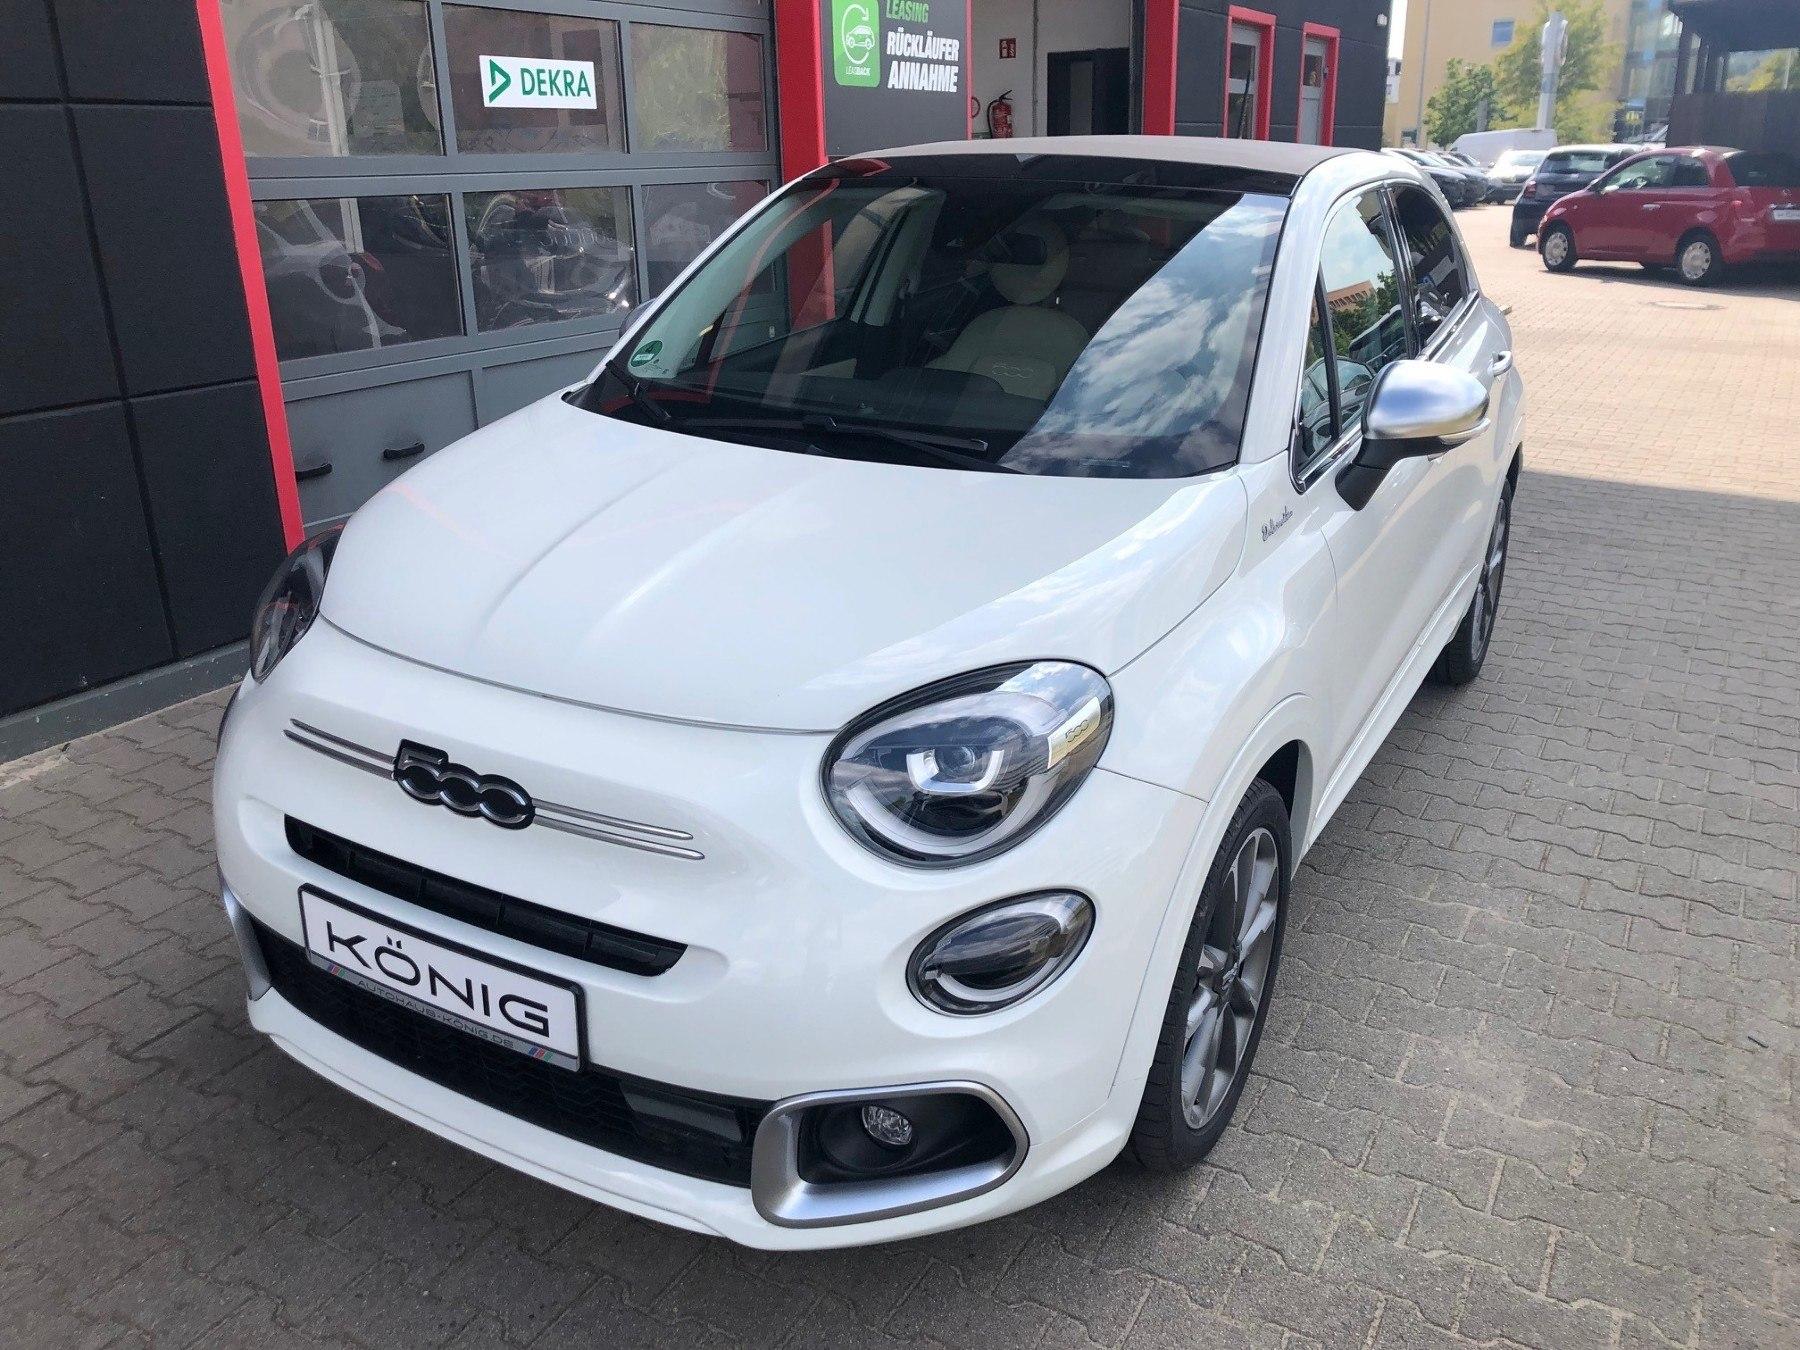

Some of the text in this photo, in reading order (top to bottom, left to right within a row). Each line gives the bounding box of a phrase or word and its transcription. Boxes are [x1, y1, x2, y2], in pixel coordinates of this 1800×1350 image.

[886, 0, 929, 23] LEASING
[886, 26, 960, 61] RÜCKLÄUFER
[520, 67, 591, 97] DEKRA
[887, 60, 959, 92] ANNAHME
[394, 738, 535, 830] 500
[326, 920, 550, 1038] KÖNIG
[357, 979, 515, 1049] AUTOHAUS-KÖNIG.DE
